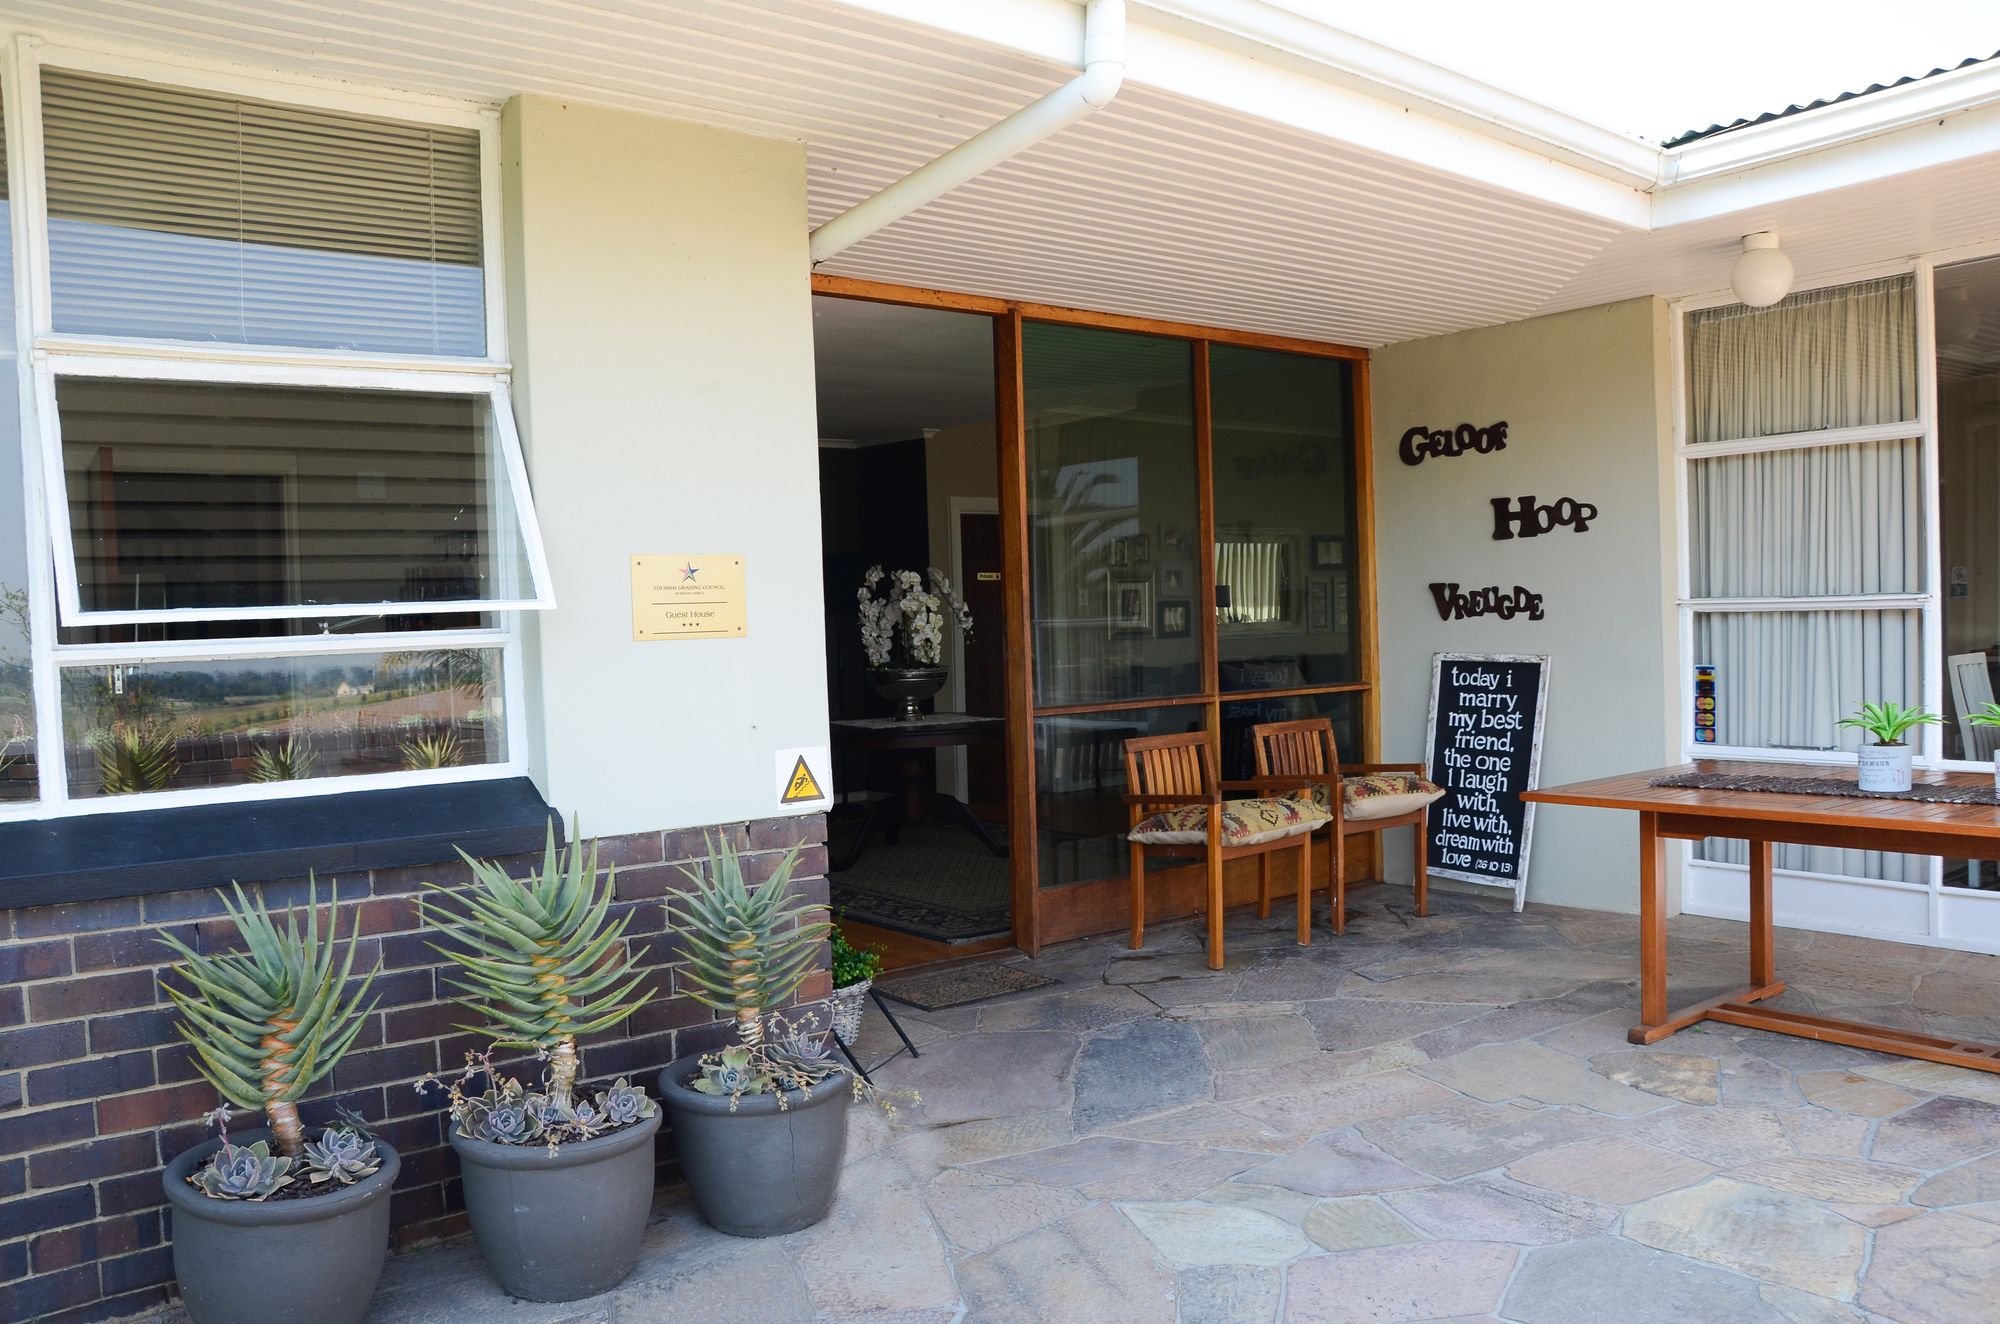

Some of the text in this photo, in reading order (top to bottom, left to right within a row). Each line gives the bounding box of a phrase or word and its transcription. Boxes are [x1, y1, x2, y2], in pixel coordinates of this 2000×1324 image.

[1490, 496, 1598, 540] HOOP
[665, 610, 715, 619] Guest House
[1451, 666, 1512, 690] today i
[1459, 692, 1518, 712] marry
[1448, 709, 1523, 731] my best
[1455, 728, 1515, 752] friend,
[1444, 748, 1511, 771] the one
[1459, 769, 1508, 793] laugh
[1457, 791, 1500, 814] with,
[1442, 807, 1512, 835] live with,
[1435, 829, 1514, 854] dream with
[1441, 848, 1472, 867] love
